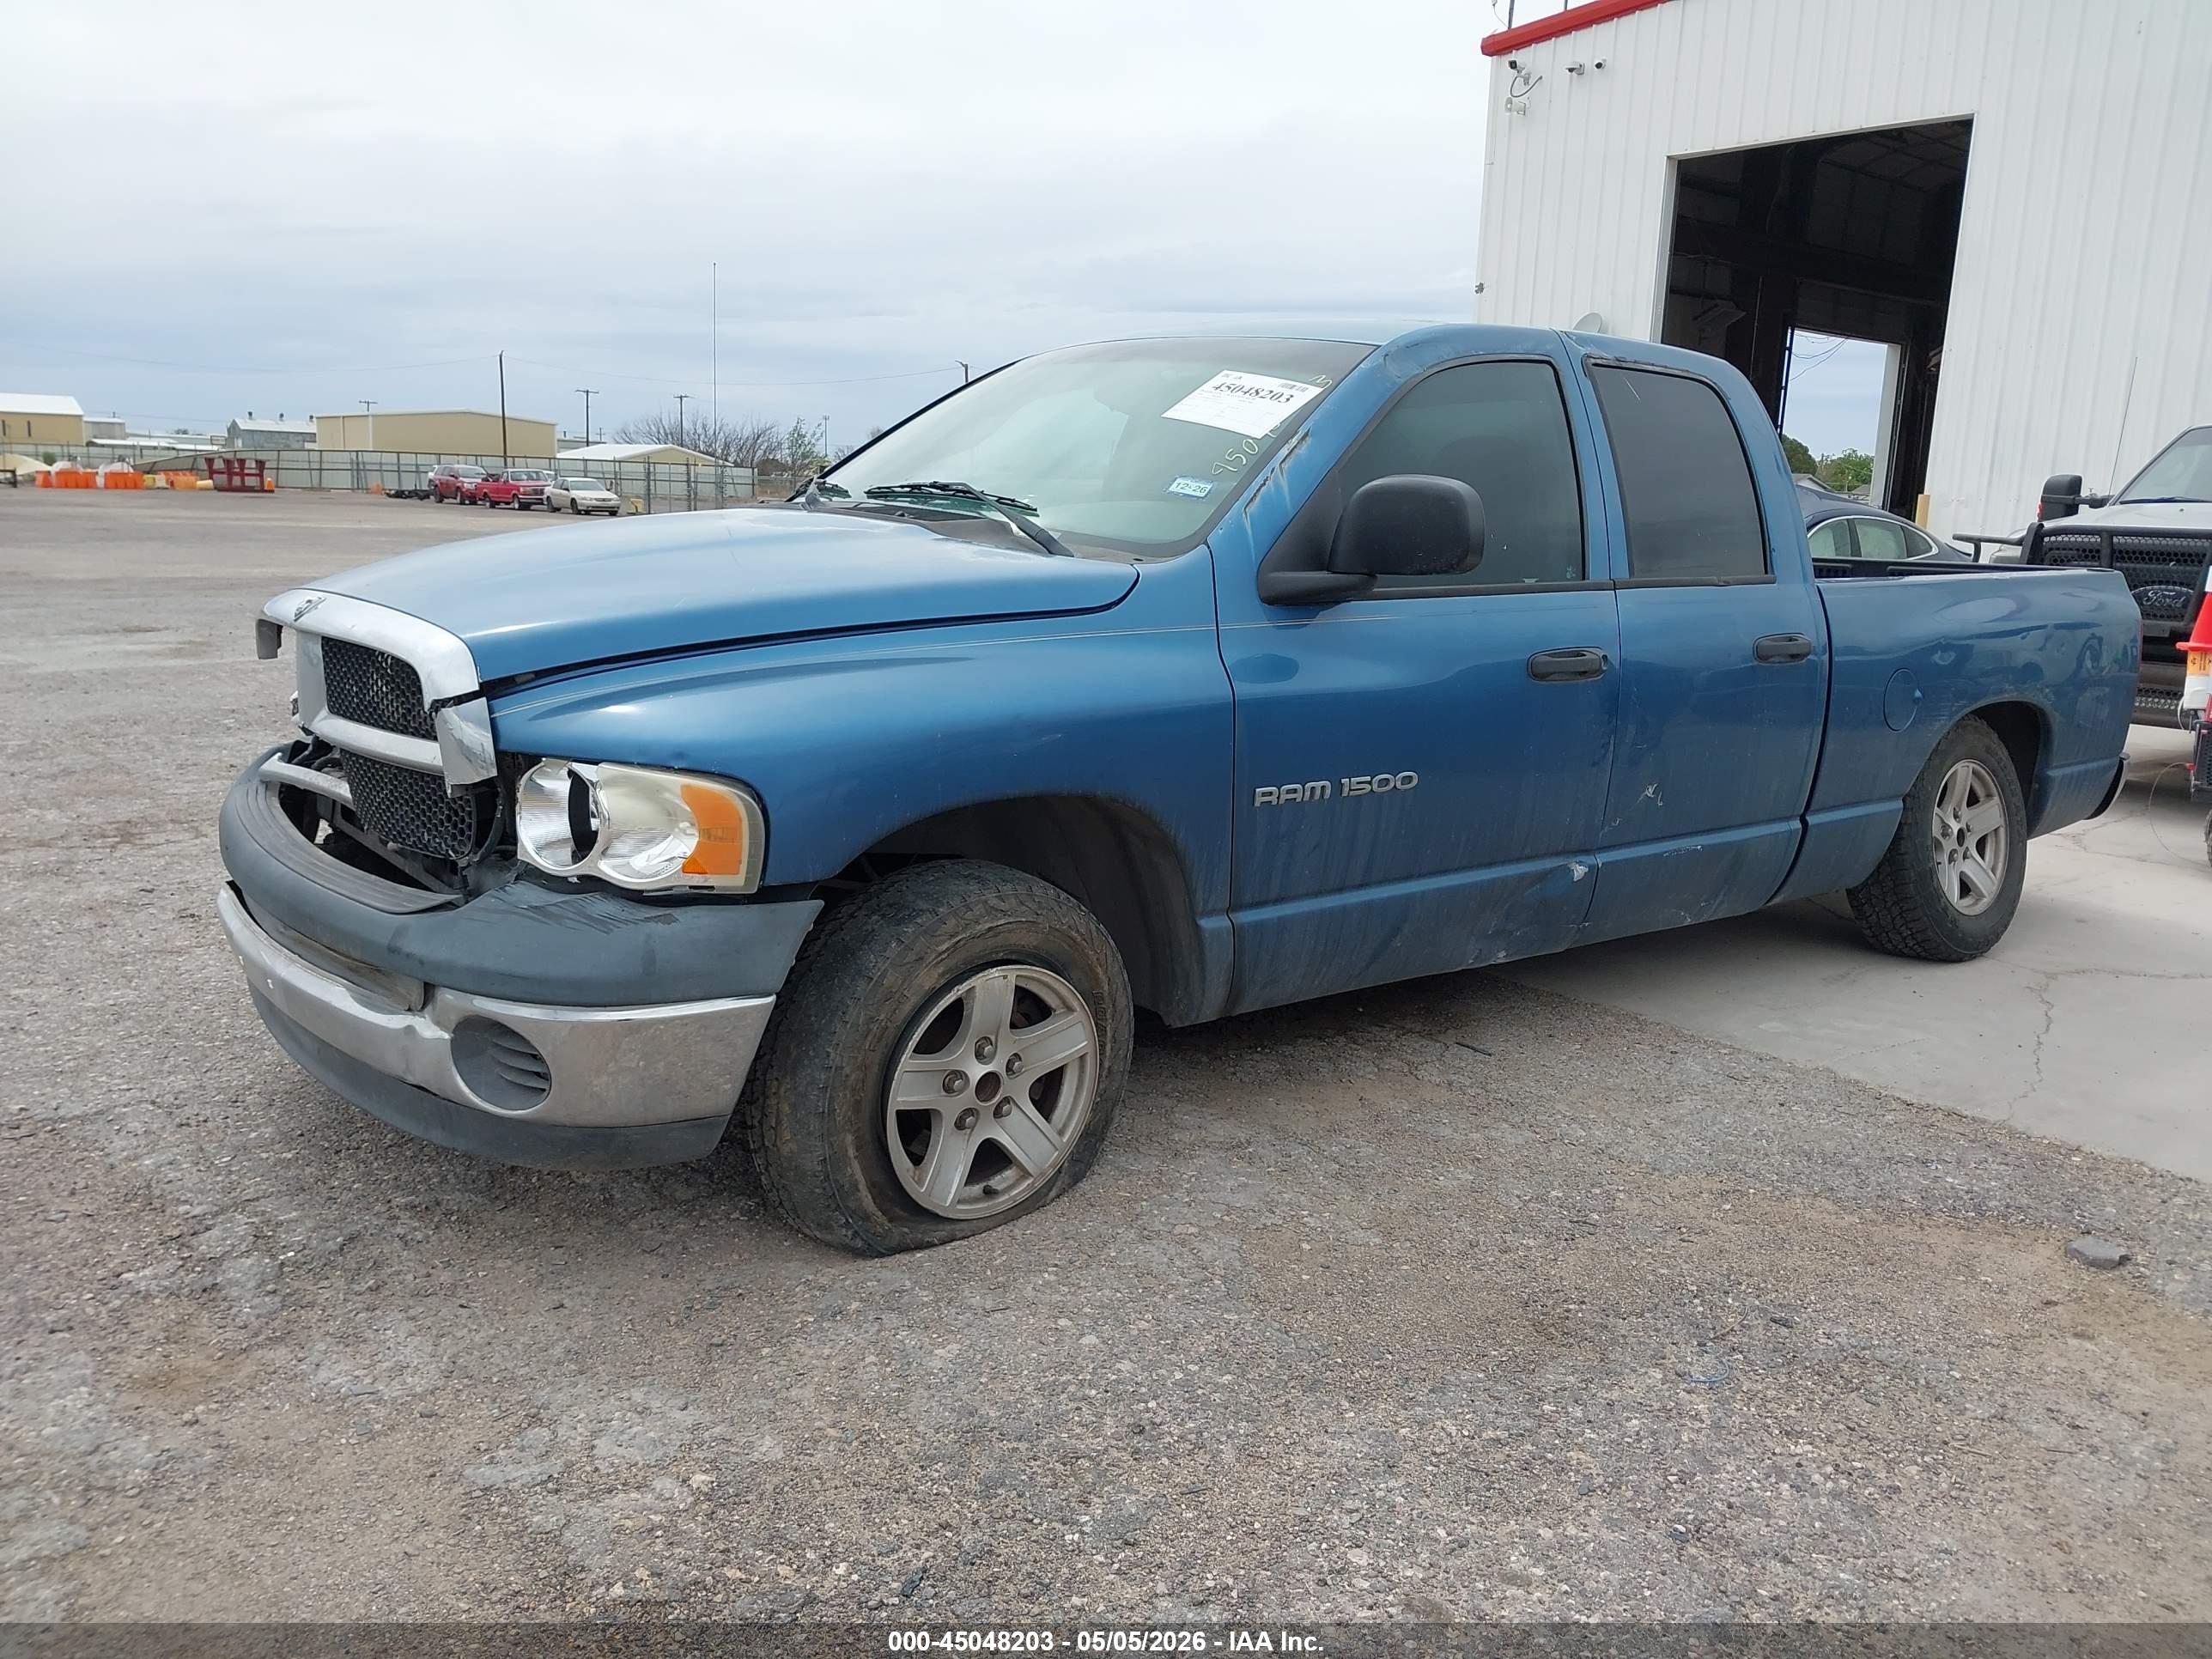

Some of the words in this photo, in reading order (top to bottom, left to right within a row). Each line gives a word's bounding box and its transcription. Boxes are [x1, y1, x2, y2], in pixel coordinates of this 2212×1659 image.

[1212, 382, 1295, 404] 45048203
[2142, 590, 2186, 608] Ford
[1254, 781, 1331, 807] RAM
[1340, 771, 1419, 797] 1500
